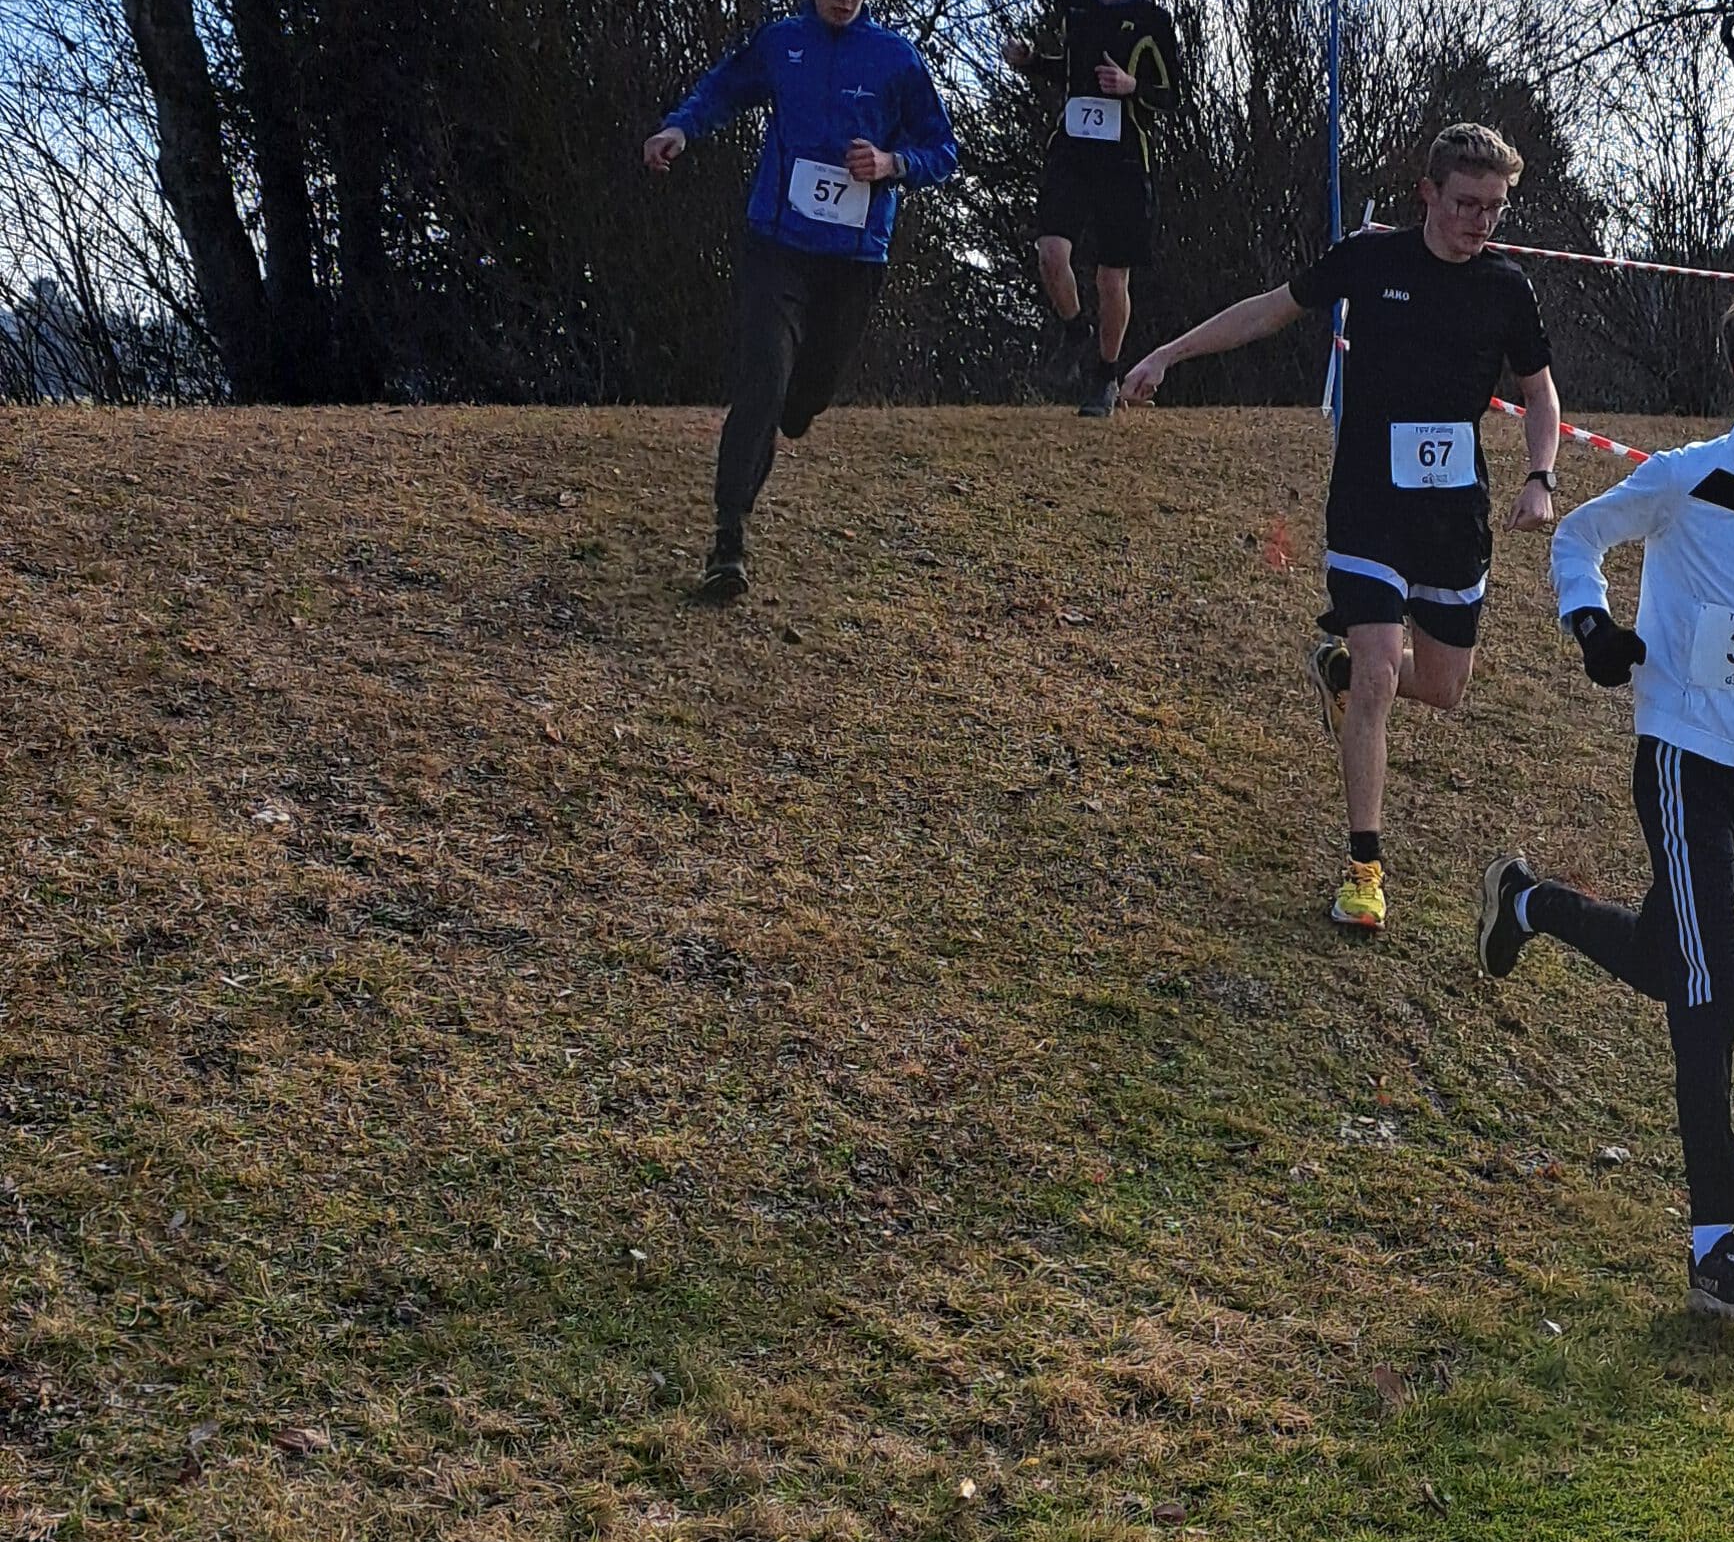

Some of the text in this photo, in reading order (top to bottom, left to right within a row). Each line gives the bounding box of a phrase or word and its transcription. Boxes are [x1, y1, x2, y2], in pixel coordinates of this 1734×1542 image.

[1081, 108, 1104, 126] 73
[813, 178, 849, 206] 57
[1382, 288, 1410, 301] JAKO
[1418, 440, 1454, 467] 67
